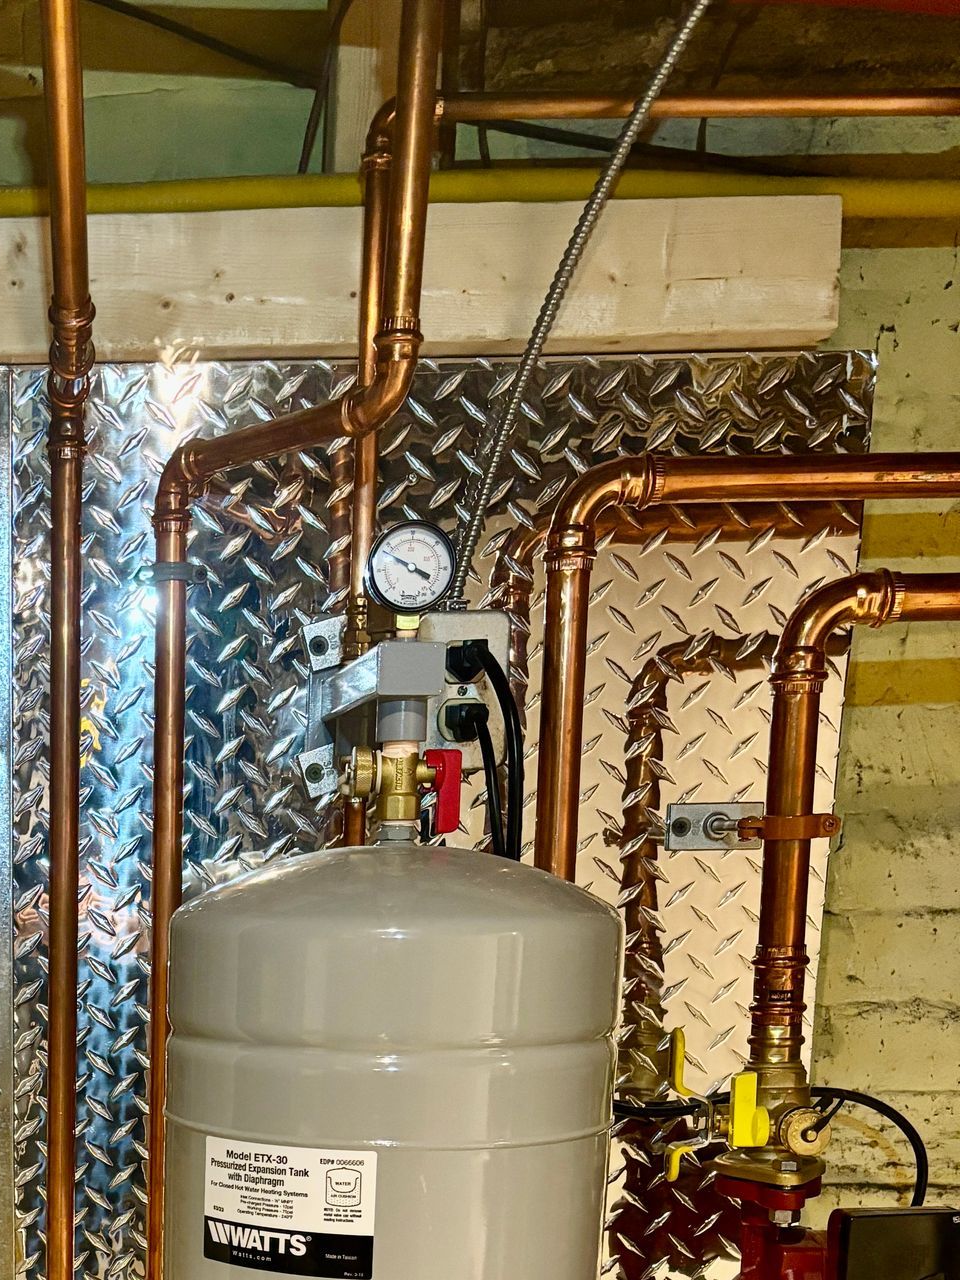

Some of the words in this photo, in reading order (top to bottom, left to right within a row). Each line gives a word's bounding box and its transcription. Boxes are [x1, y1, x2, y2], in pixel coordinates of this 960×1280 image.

[226, 1150, 251, 1161] Model
[254, 1153, 288, 1164] ETX-30
[211, 1158, 246, 1172] Pressurized
[249, 1164, 286, 1176] Expansion
[289, 1168, 309, 1177] Tank
[228, 1172, 242, 1181] with
[244, 1174, 284, 1187] Diaphragm
[261, 1187, 281, 1196] Heating
